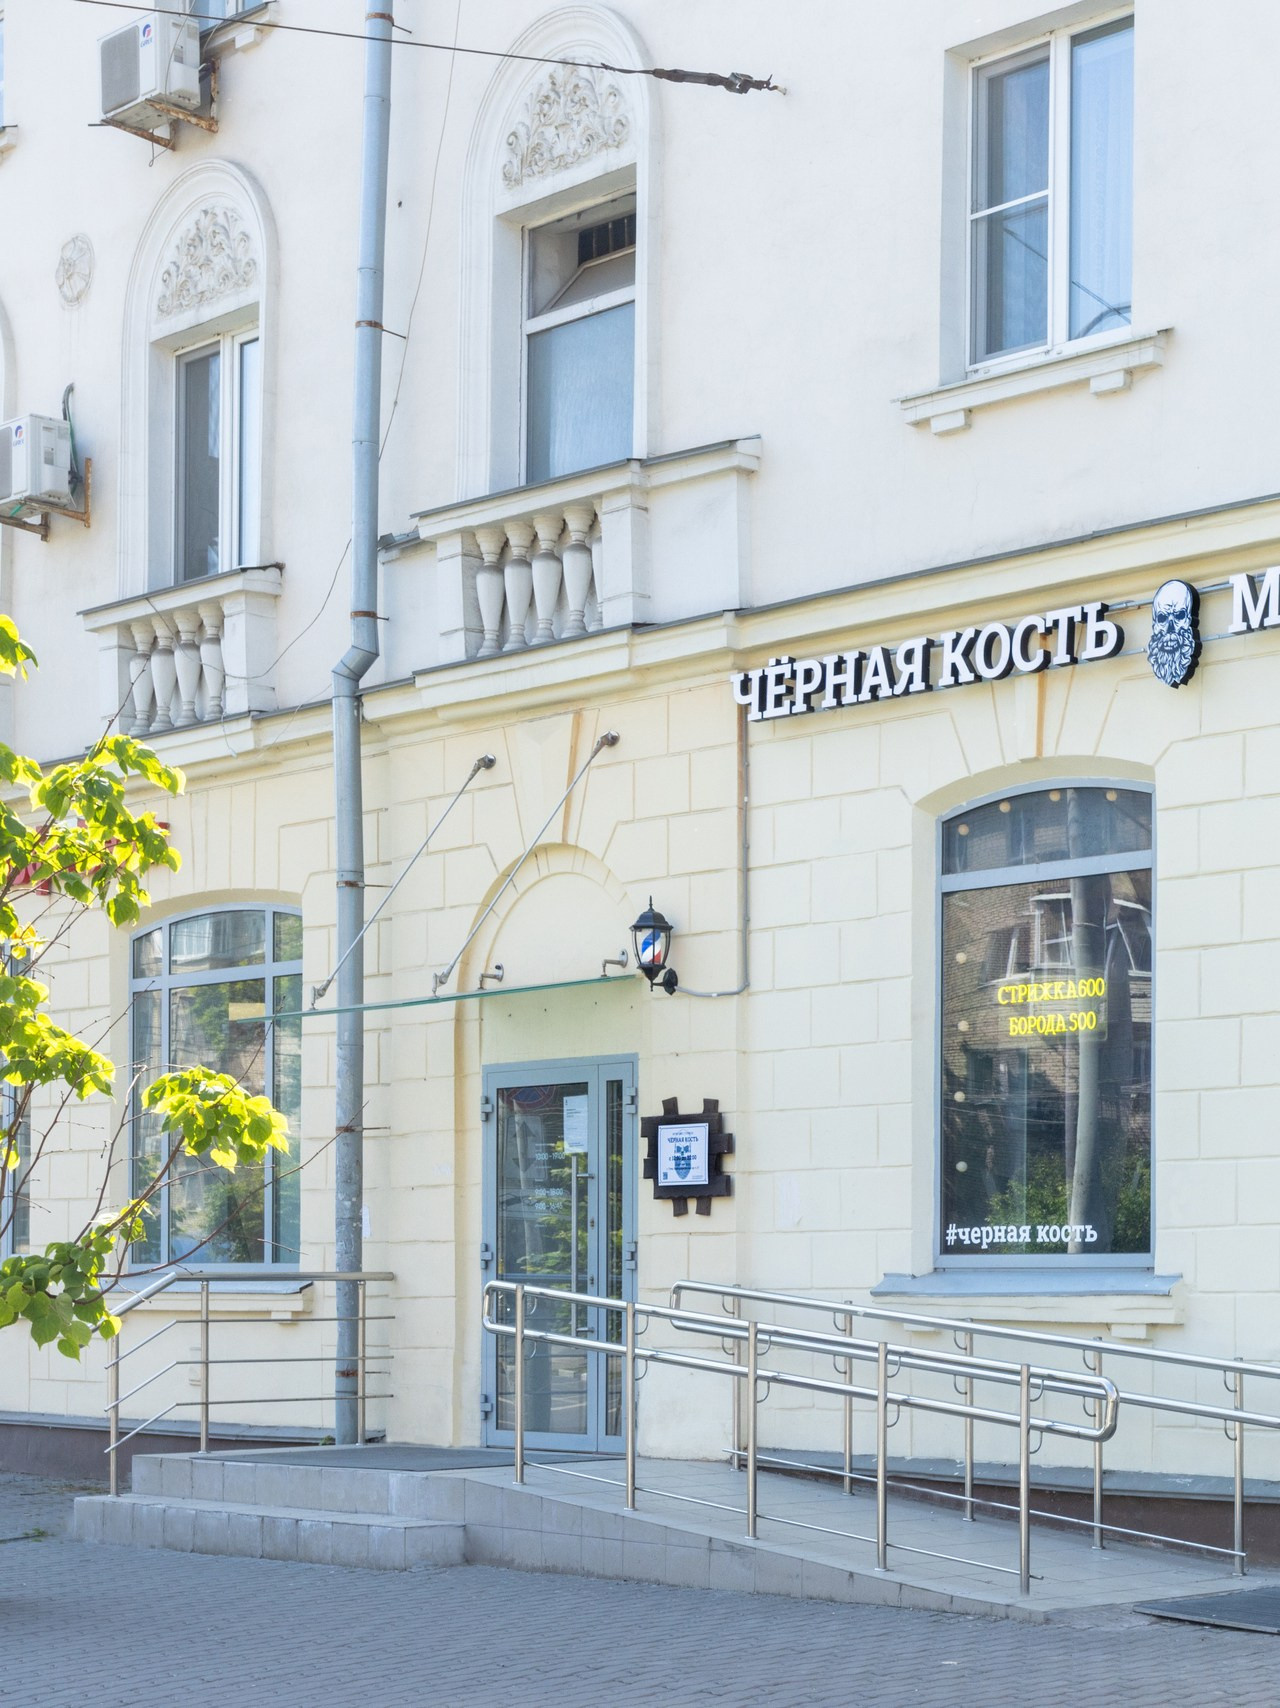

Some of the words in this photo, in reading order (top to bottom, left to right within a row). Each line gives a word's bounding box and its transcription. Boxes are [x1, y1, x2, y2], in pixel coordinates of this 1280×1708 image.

[730, 638, 934, 722] ЧЁРНАЯ
[939, 603, 1124, 688] КОСТЬ
[998, 980, 1078, 1005] СТРИЖКА
[1078, 977, 1105, 998] 600
[1009, 1013, 1068, 1036] БОРОДА
[1069, 1011, 1097, 1031] 500
[946, 1223, 1032, 1249] #черная
[1036, 1224, 1098, 1243] кость
